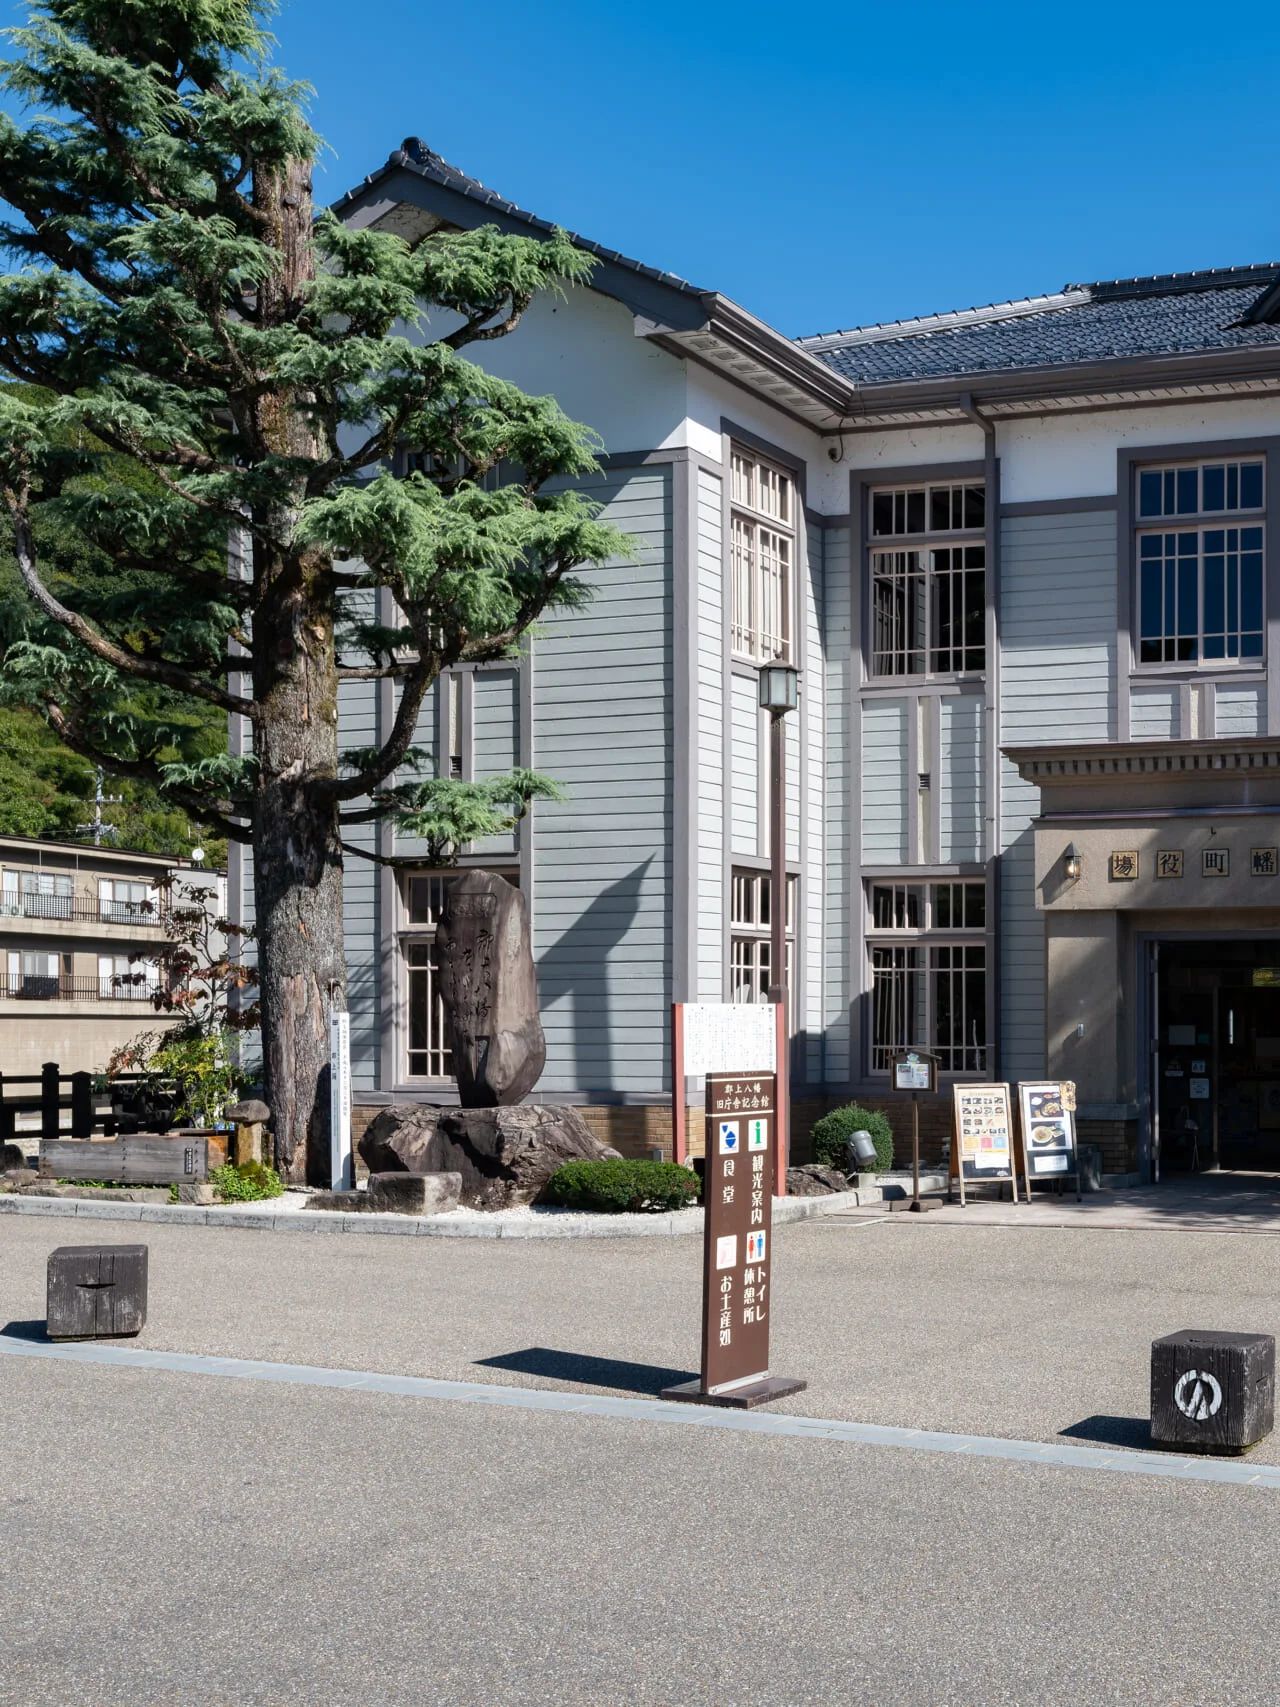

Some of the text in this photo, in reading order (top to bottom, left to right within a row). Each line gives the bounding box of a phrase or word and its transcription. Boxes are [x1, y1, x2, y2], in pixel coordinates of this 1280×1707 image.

[716, 1096, 770, 1110] 旧庁舎記念館
[724, 1083, 762, 1095] 郡上八幡
[722, 1159, 735, 1204] 食堂
[751, 1155, 764, 1225] 観光案内
[719, 1275, 733, 1347] お土産処
[744, 1268, 755, 1325] 休憩所
[756, 1266, 767, 1322] トイレ
